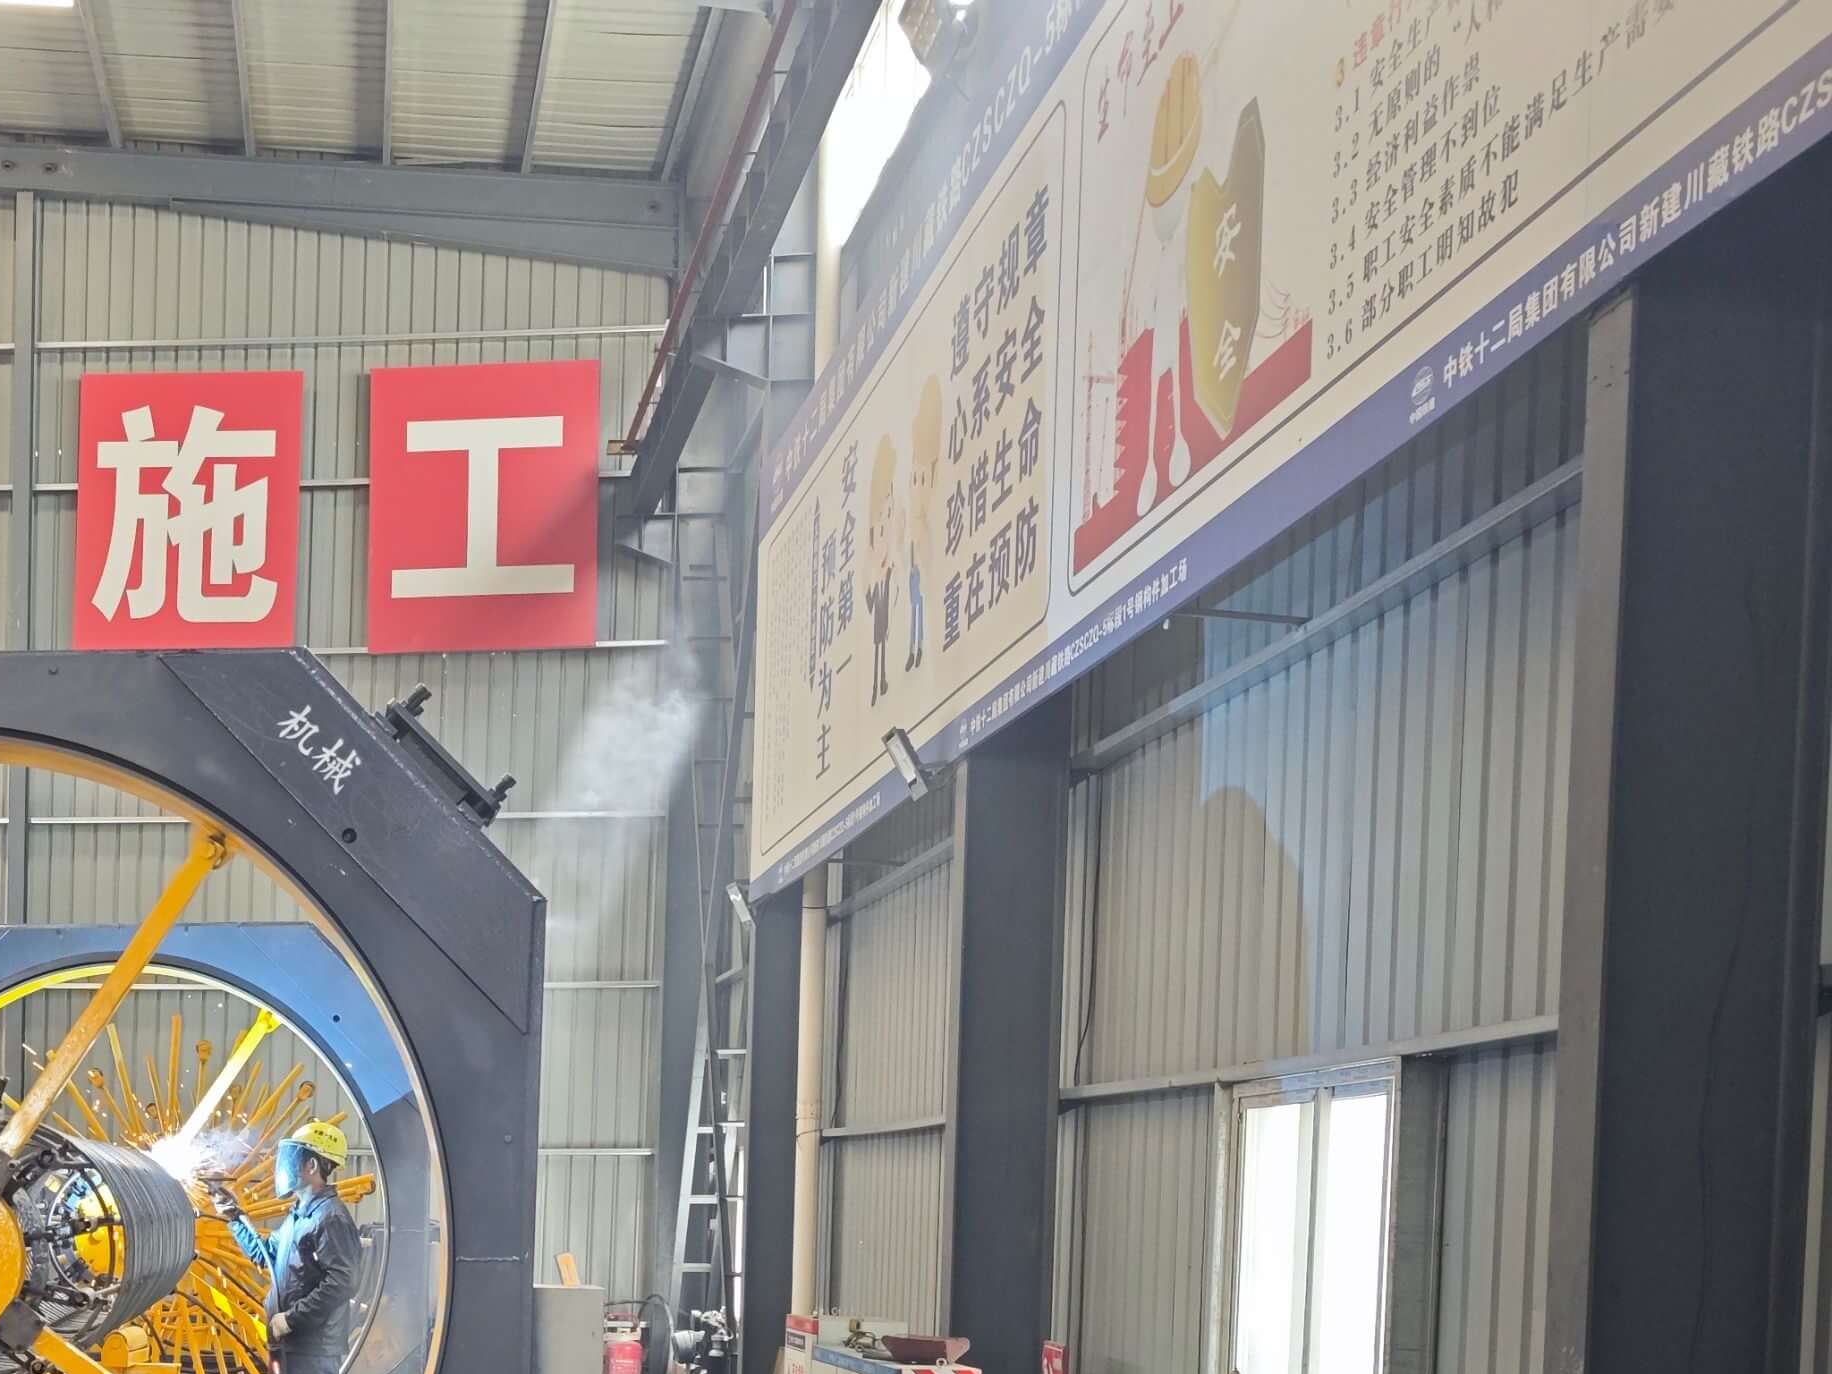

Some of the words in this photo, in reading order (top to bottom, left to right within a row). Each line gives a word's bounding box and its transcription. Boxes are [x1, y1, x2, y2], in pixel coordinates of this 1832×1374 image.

[1329, 224, 1355, 270] 3.4
[1364, 84, 1501, 241] 安全管理不到位
[1331, 178, 1358, 224] 3.3
[1366, 51, 1480, 192] 经济利益作祟
[1333, 131, 1359, 178] 3.2
[1335, 87, 1359, 132] 3.1
[950, 184, 1050, 381] 遵守规章
[1213, 202, 1241, 382] 安全
[1327, 318, 1353, 360] 3.6
[1360, 168, 1520, 334] 部分职工明知故犯
[1328, 272, 1354, 315] 3.5
[948, 296, 1046, 467] 心系安全
[836, 440, 858, 674] 安全第一
[945, 397, 1043, 558] 珍惜生命
[816, 529, 837, 780] 预防为主
[942, 499, 1039, 653] 重在预防
[276, 704, 361, 795] 机械
